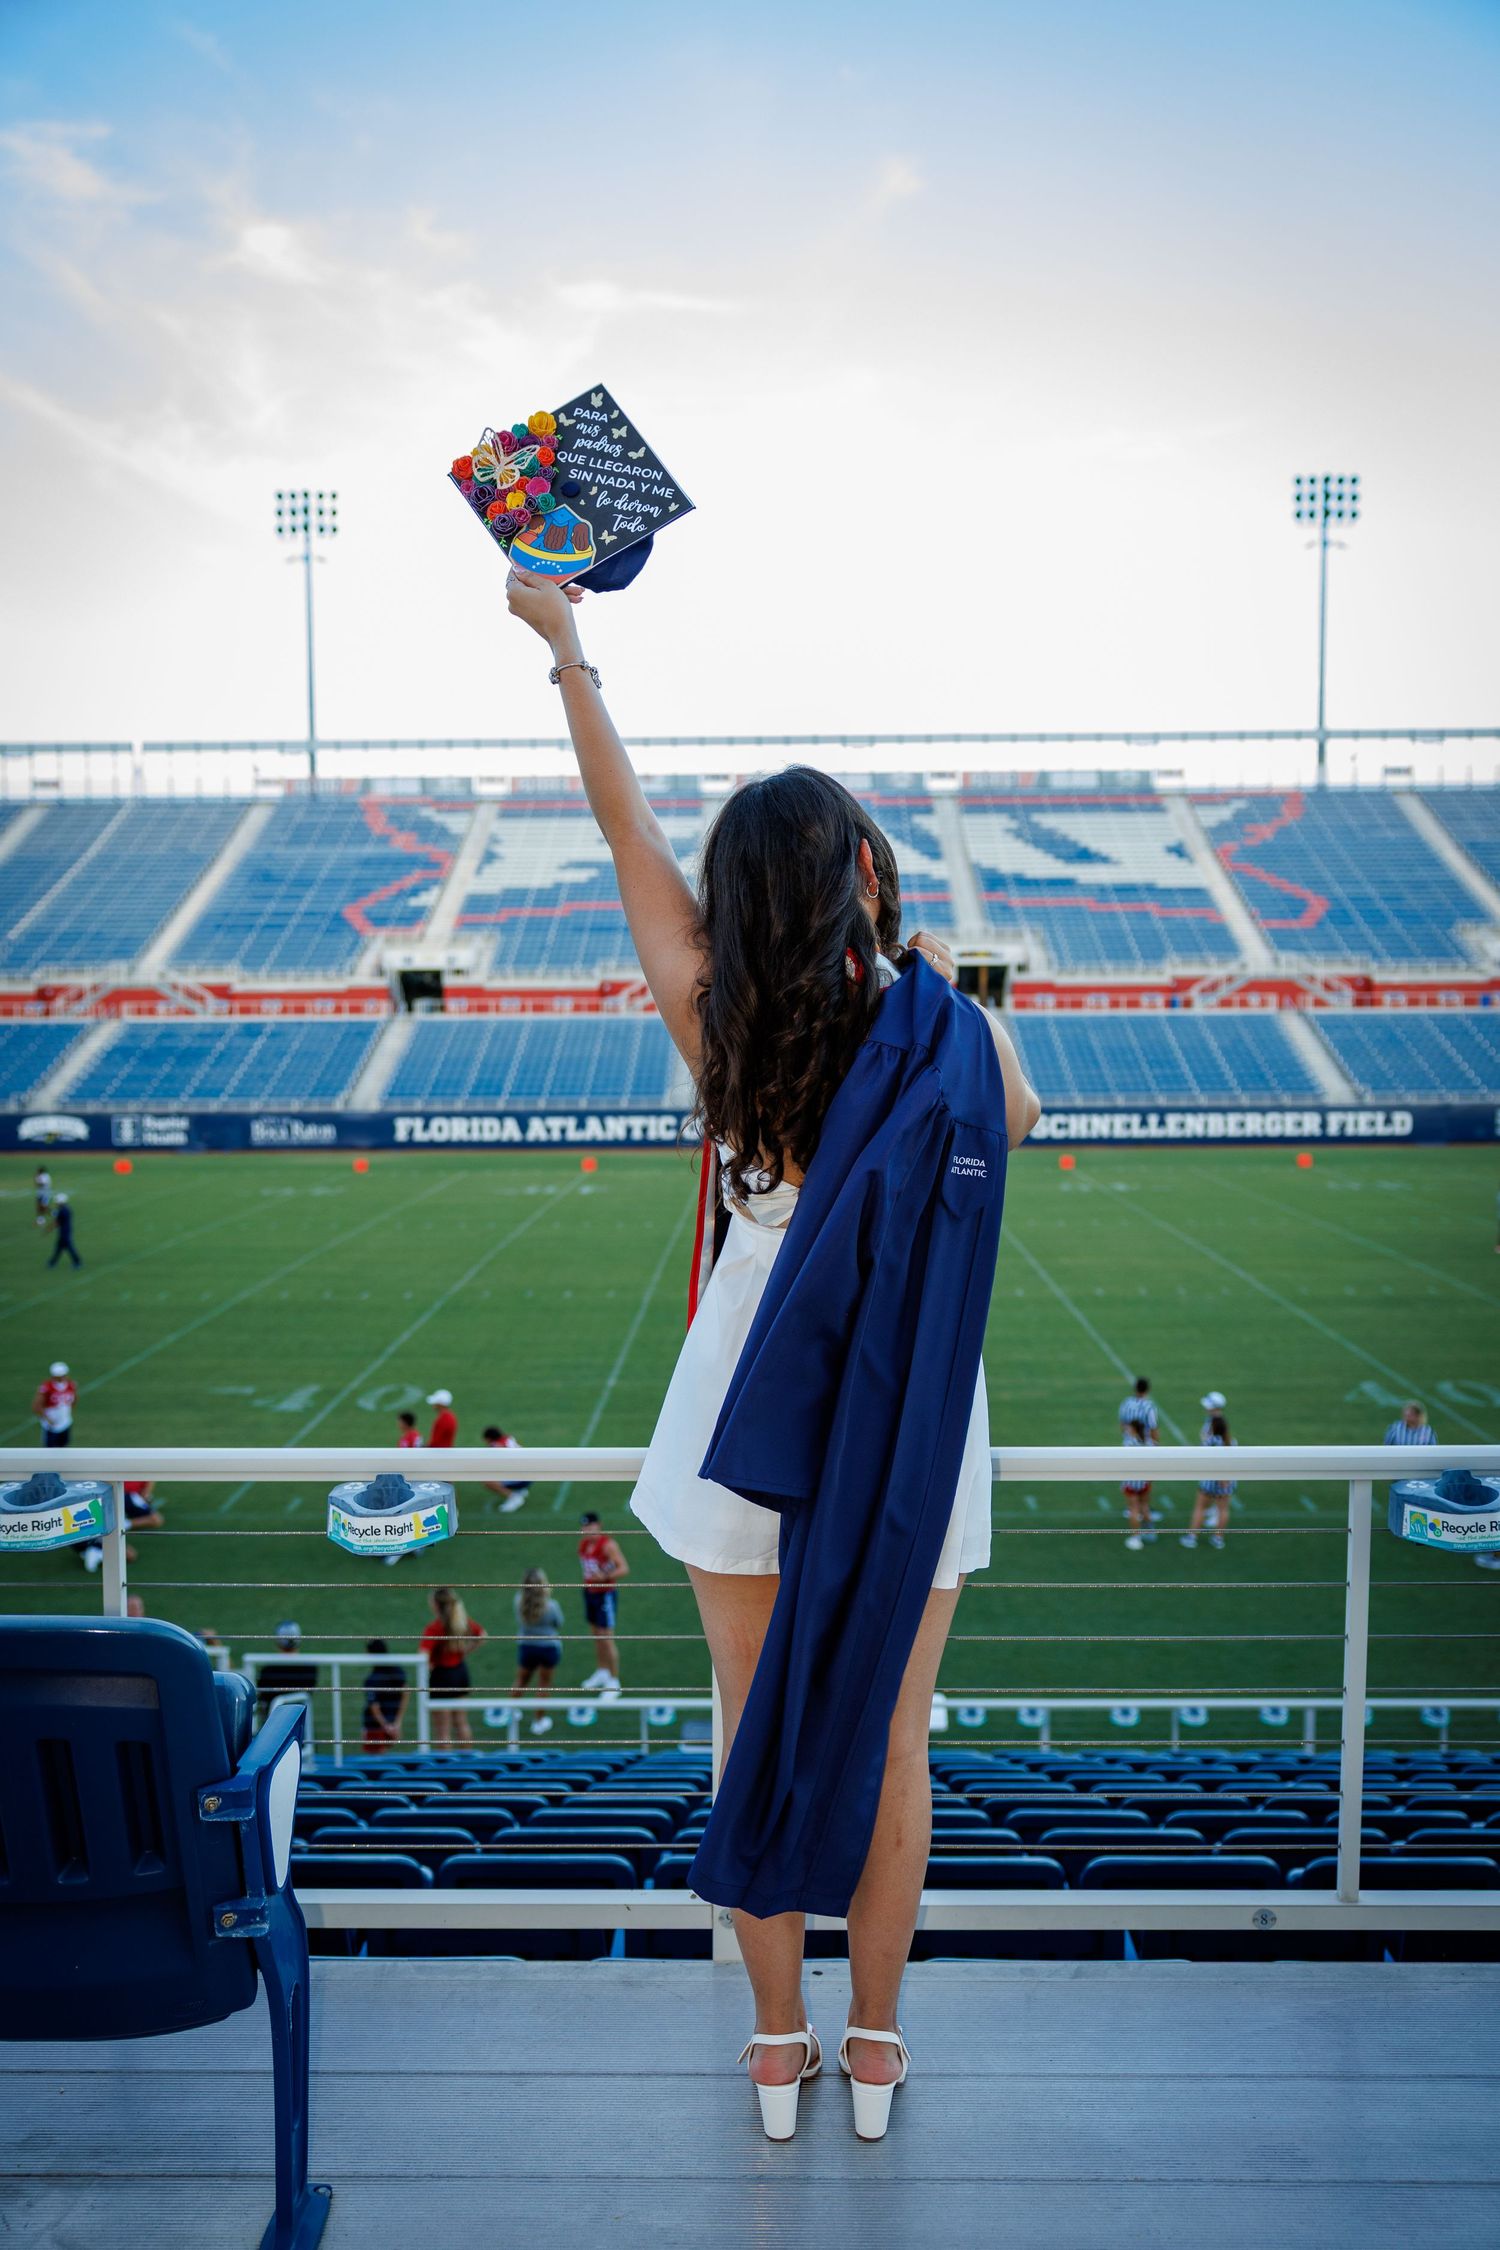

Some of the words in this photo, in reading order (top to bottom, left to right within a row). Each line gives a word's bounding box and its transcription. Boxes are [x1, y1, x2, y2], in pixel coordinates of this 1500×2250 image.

[573, 408, 608, 422] PARA
[575, 422, 602, 437] mis
[573, 435, 625, 458] padres
[556, 450, 586, 466] QUE
[588, 457, 664, 481] LLEGARON
[568, 468, 593, 482] SIN
[595, 474, 636, 491] NADA
[640, 482, 651, 493] Y
[652, 485, 675, 499] ME
[595, 490, 613, 508] lo
[613, 493, 663, 518] dieron
[393, 1116, 523, 1143] FLORIDA
[526, 1115, 678, 1142] ATLANTIC
[1030, 1112, 1322, 1139] SCHNELLENBERGER
[1325, 1111, 1414, 1137] FIELD
[952, 1155, 986, 1168] FLORIDA
[950, 1165, 989, 1178] ATLANTIC
[0, 1522, 28, 1534] cycle
[31, 1517, 62, 1532] Right
[347, 1521, 382, 1538] Recycle
[384, 1521, 414, 1537] Right
[1441, 1520, 1487, 1536] Recycle
